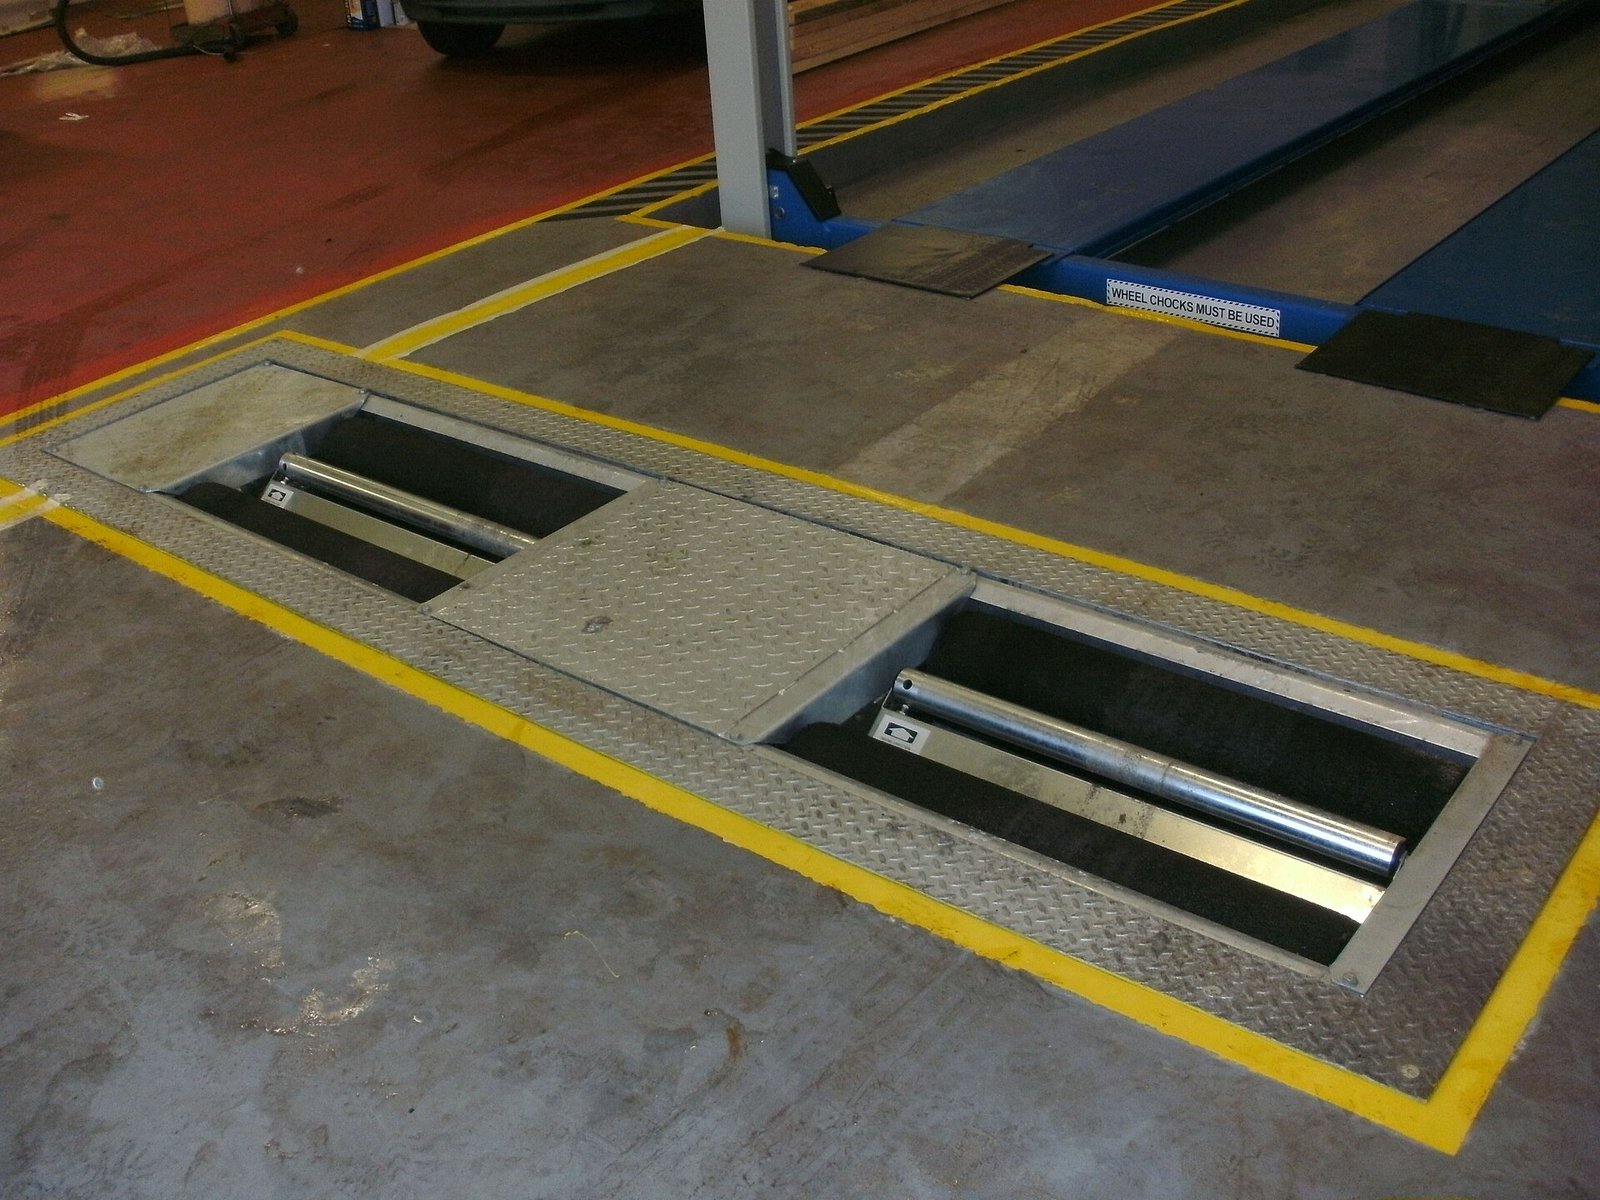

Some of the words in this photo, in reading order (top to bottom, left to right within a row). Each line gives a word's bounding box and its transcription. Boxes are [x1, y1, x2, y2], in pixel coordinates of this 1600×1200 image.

[1112, 287, 1147, 304] WHEEL
[1150, 295, 1194, 312] CHOCKS
[1196, 303, 1226, 318] MUST
[1228, 310, 1242, 322] BE
[1245, 313, 1275, 328] USED
